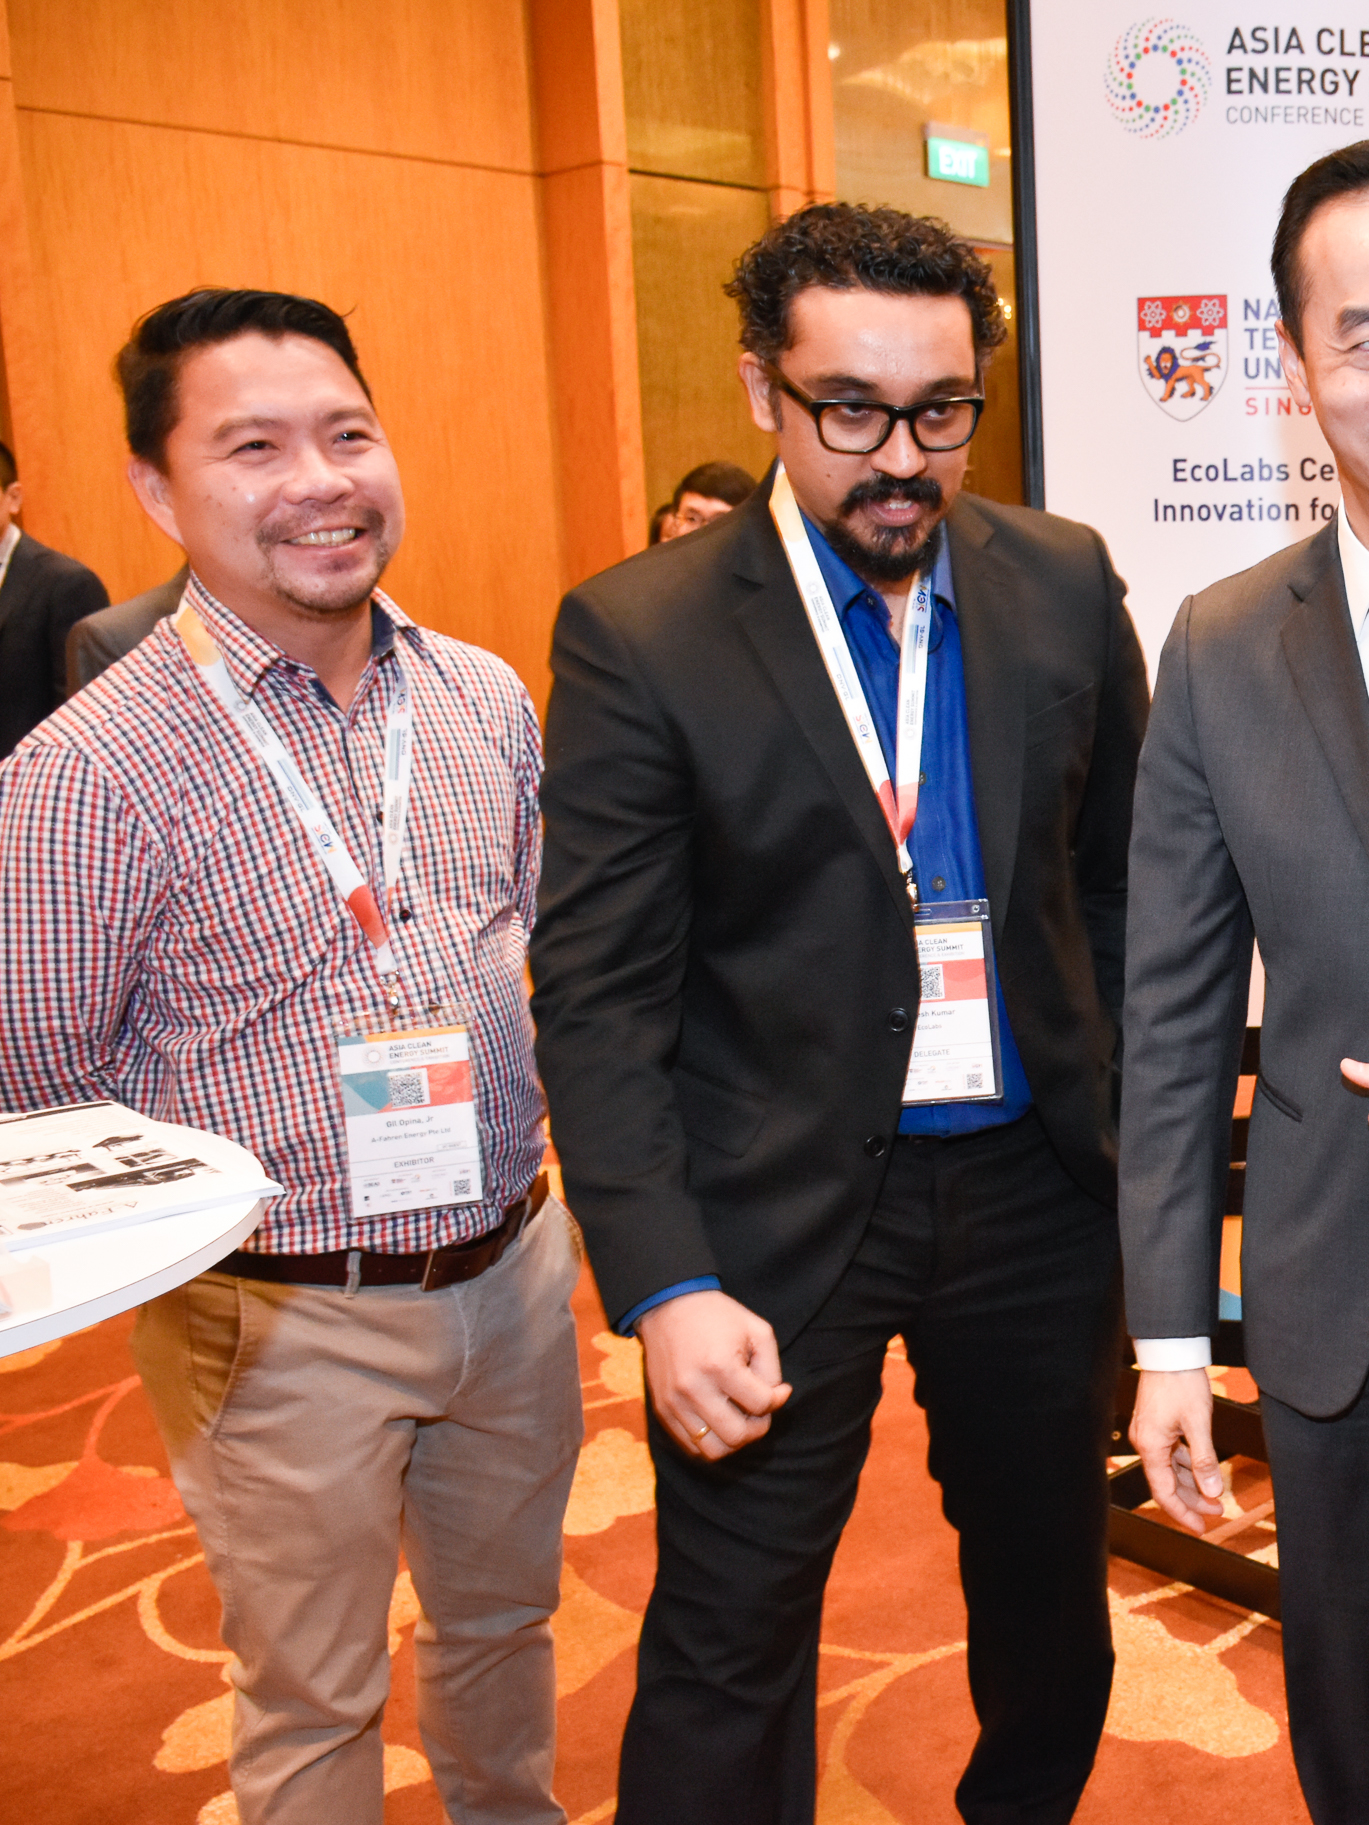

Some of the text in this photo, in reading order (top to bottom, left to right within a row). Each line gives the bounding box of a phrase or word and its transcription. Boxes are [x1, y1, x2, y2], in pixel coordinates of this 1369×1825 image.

[1227, 26, 1305, 54] ASIA
[1226, 67, 1360, 96] ENERGY
[1226, 106, 1364, 126] CONFERENCE
[938, 146, 977, 178] EXIT
[1172, 457, 1290, 483] EcoLabs
[1154, 498, 1300, 523] Innovation
[937, 944, 963, 952] SUMMIT
[389, 1051, 418, 1059] ENERGY
[420, 1047, 448, 1055] SUMMIT
[914, 1049, 950, 1057] DELEGATE
[386, 1120, 397, 1128] Gil
[394, 1157, 434, 1168] EXHIBITOR
